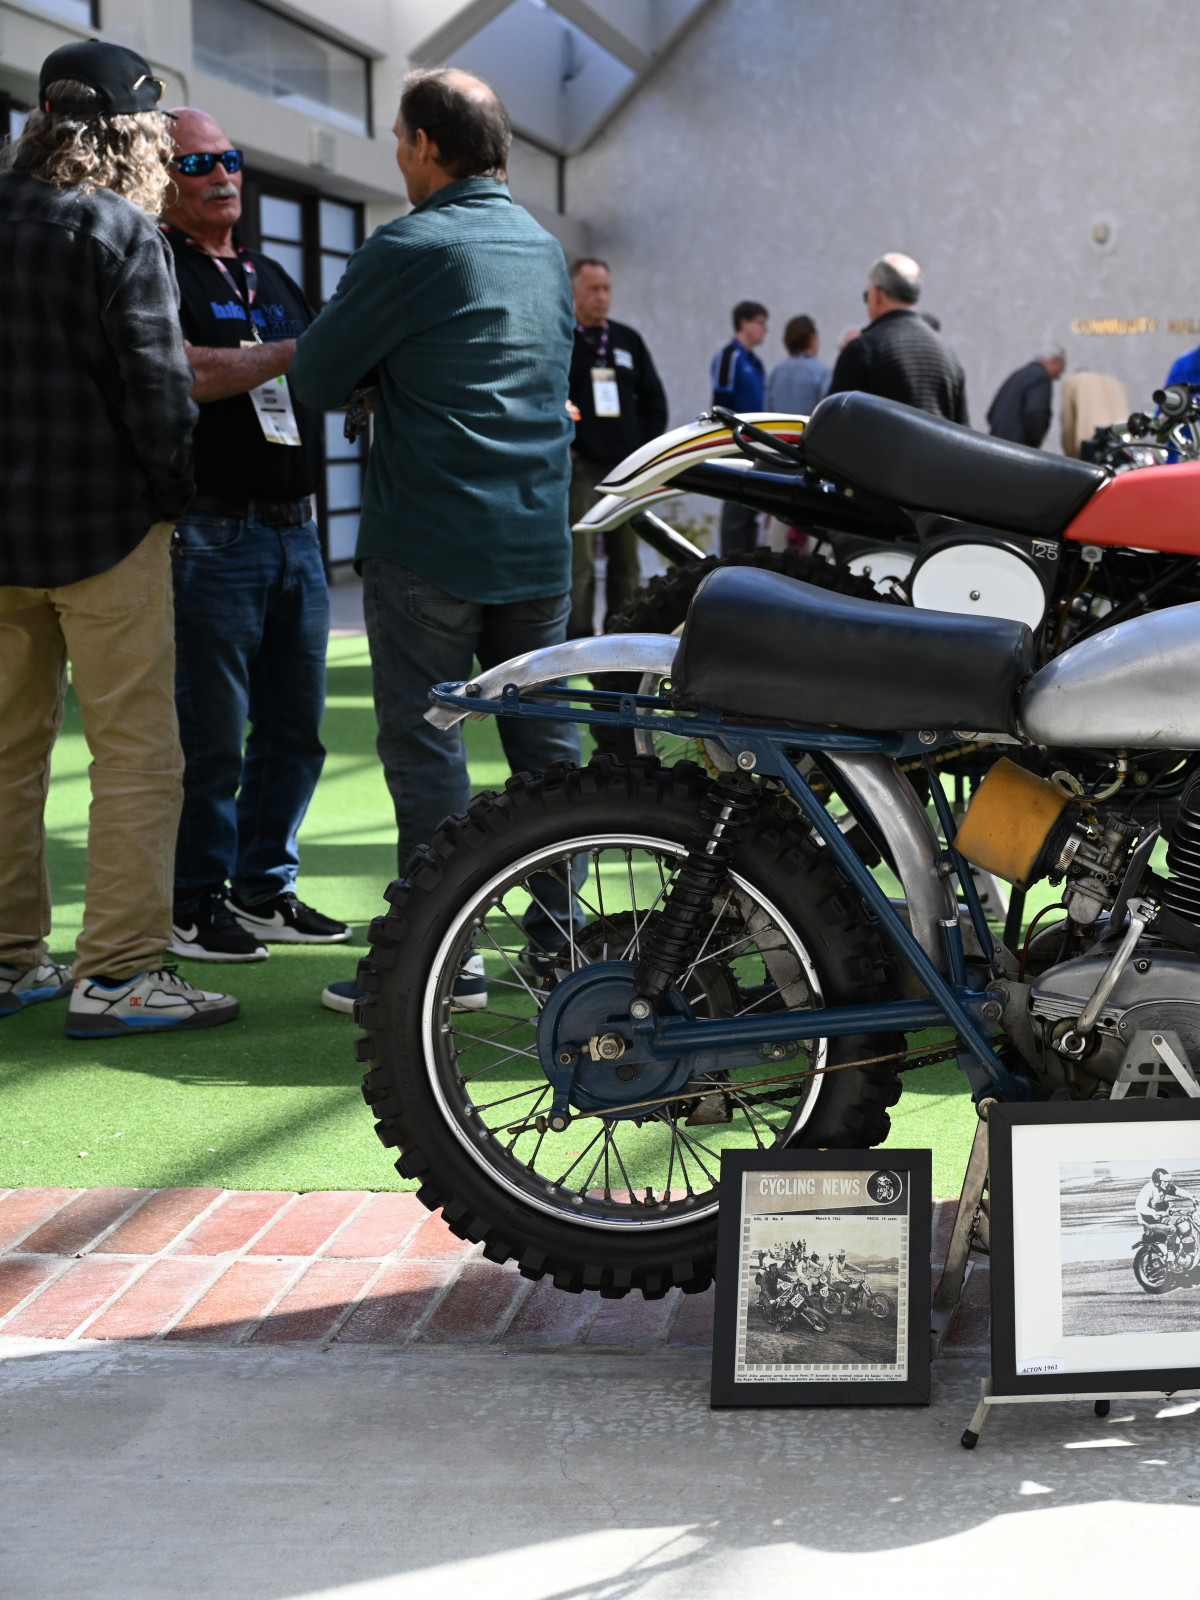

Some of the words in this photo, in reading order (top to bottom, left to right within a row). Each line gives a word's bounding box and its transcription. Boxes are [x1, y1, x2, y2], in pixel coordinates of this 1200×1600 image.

[1032, 543, 1058, 561] 125
[759, 1178, 816, 1196] CYCLING
[822, 1178, 860, 1195] NEWS
[1021, 1366, 1042, 1374] ACTON
